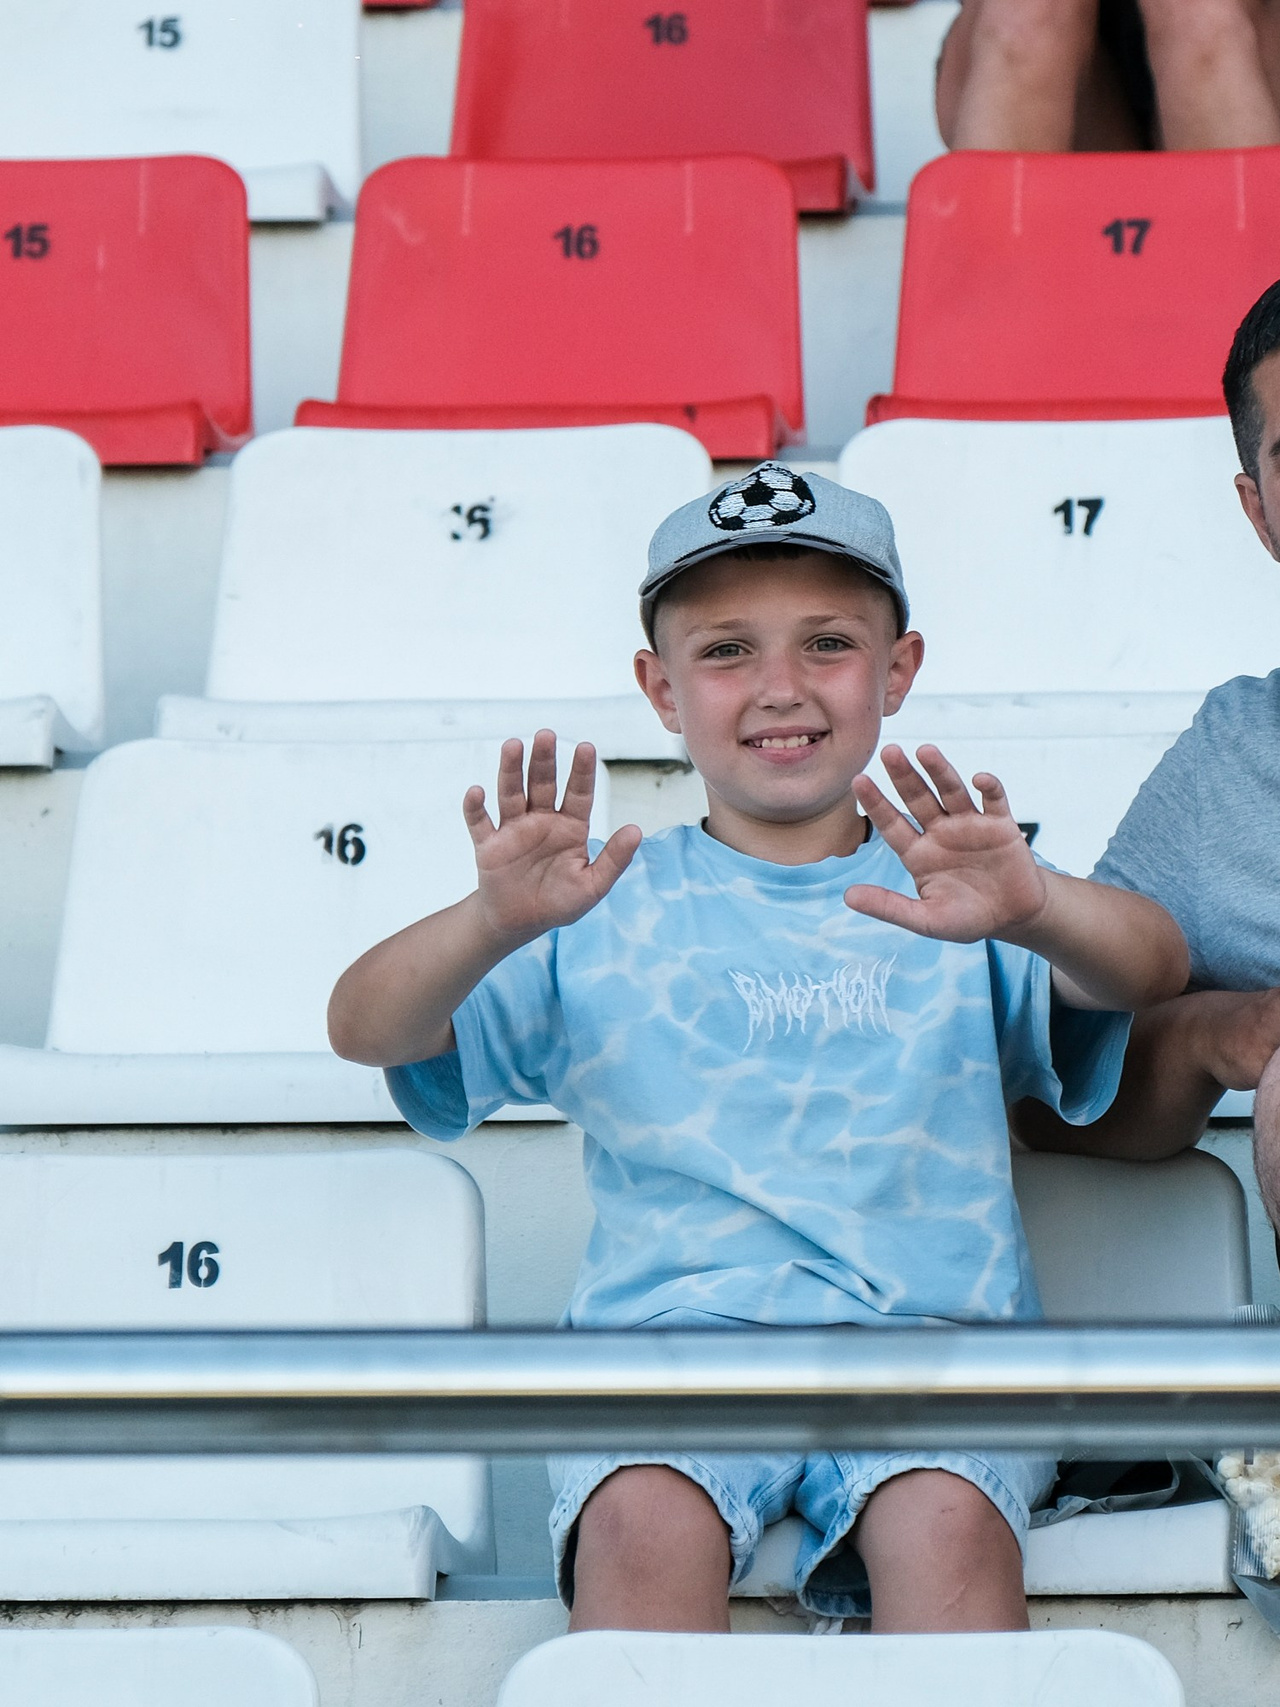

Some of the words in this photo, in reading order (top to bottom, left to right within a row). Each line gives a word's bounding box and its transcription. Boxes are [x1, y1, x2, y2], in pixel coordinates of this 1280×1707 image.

[137, 17, 181, 48] 15
[644, 14, 688, 46] 16
[4, 225, 51, 260] 15
[554, 224, 599, 260] 16
[1101, 218, 1153, 255] 17
[1053, 497, 1105, 536] 17
[315, 824, 366, 866] 16
[157, 1241, 220, 1289] 16
